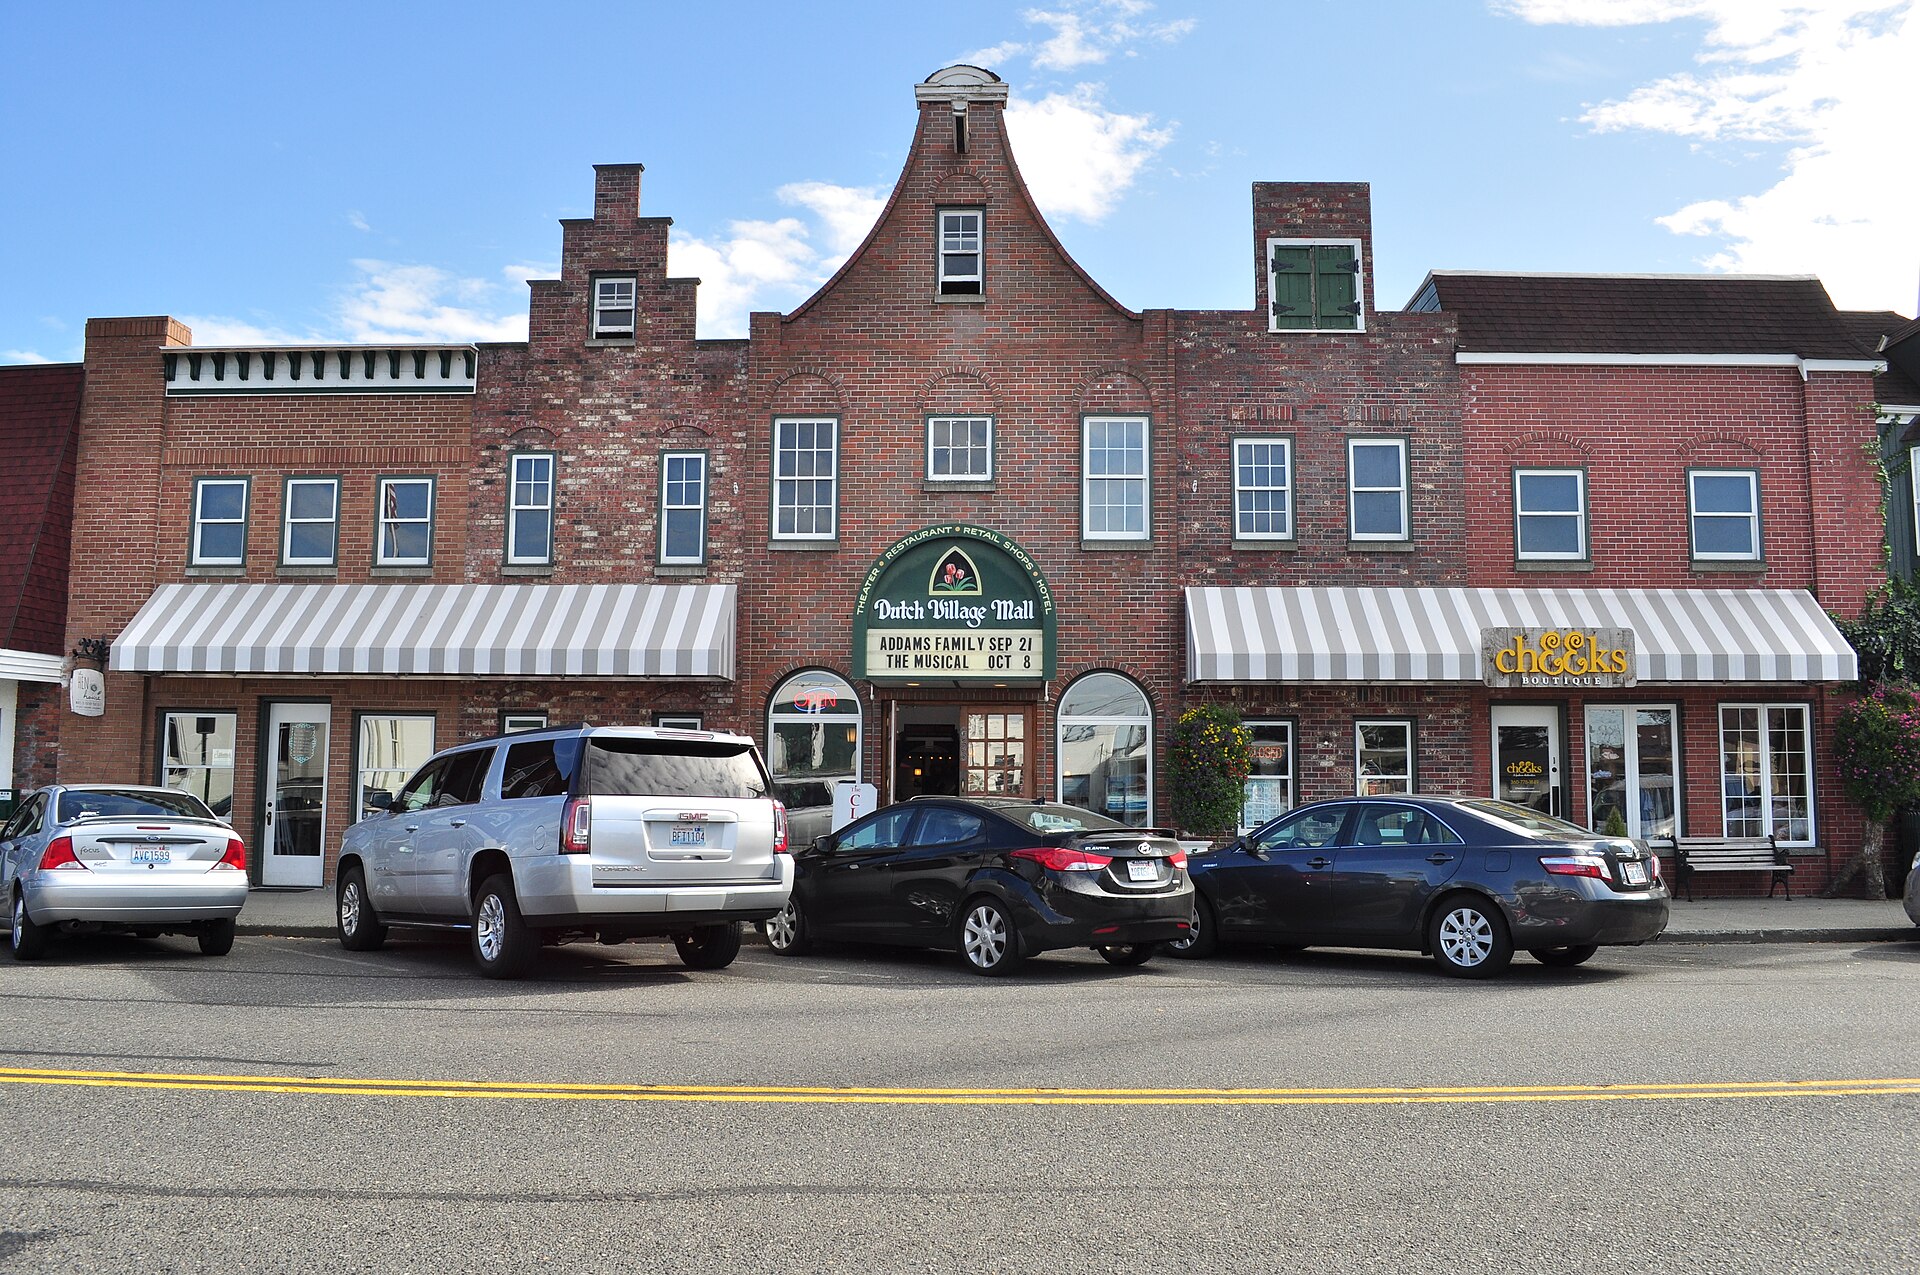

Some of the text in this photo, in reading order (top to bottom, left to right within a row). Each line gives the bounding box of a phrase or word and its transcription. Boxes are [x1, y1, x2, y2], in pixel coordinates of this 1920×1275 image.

[856, 526, 1053, 615] THEATER RESTAURANT RETAIL SHOPS HOTEL
[873, 599, 1034, 628] Dutch Village Mall
[880, 637, 931, 651] ADDAMS
[935, 637, 985, 651] FAMILY
[989, 637, 1013, 651] SEP
[886, 654, 1031, 669] THE MUSICAL OCT 8
[1522, 676, 1602, 686] BOUTIQUE
[794, 692, 837, 708] OPEN
[678, 812, 709, 821] GMC
[134, 850, 170, 861] AVC1599
